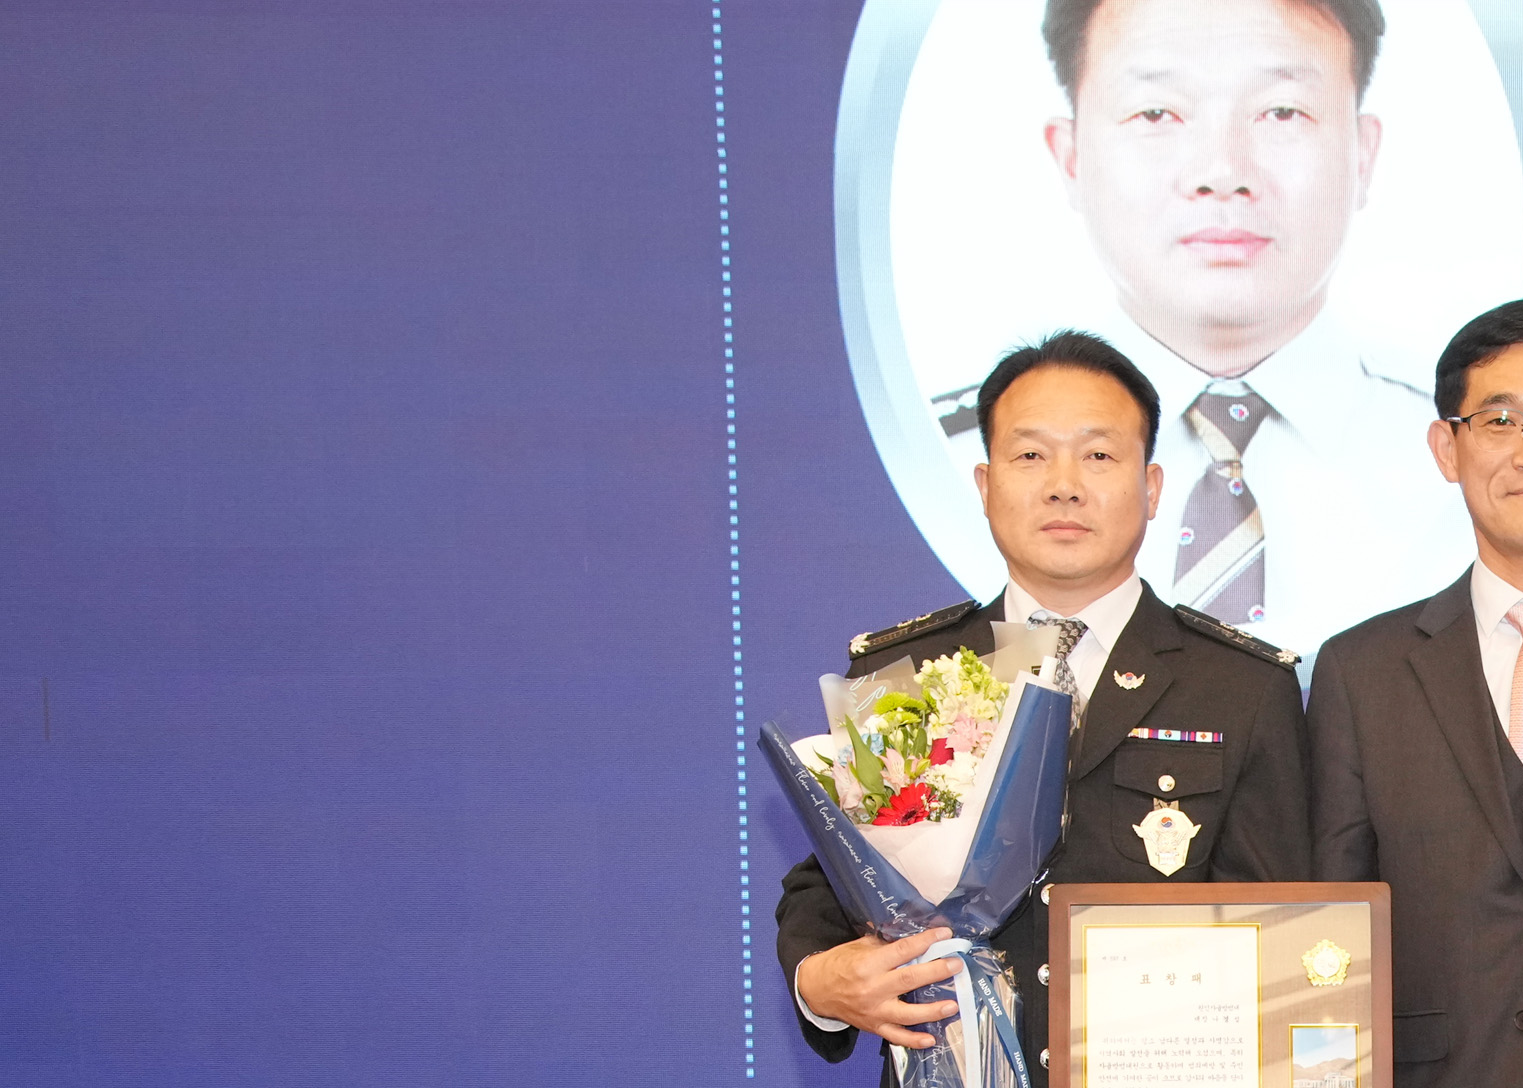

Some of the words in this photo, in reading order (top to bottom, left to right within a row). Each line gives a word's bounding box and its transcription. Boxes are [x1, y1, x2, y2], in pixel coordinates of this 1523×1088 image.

[977, 977, 992, 997] HAND
[988, 997, 1003, 1017] MADE
[1013, 1051, 1024, 1073] HAND
